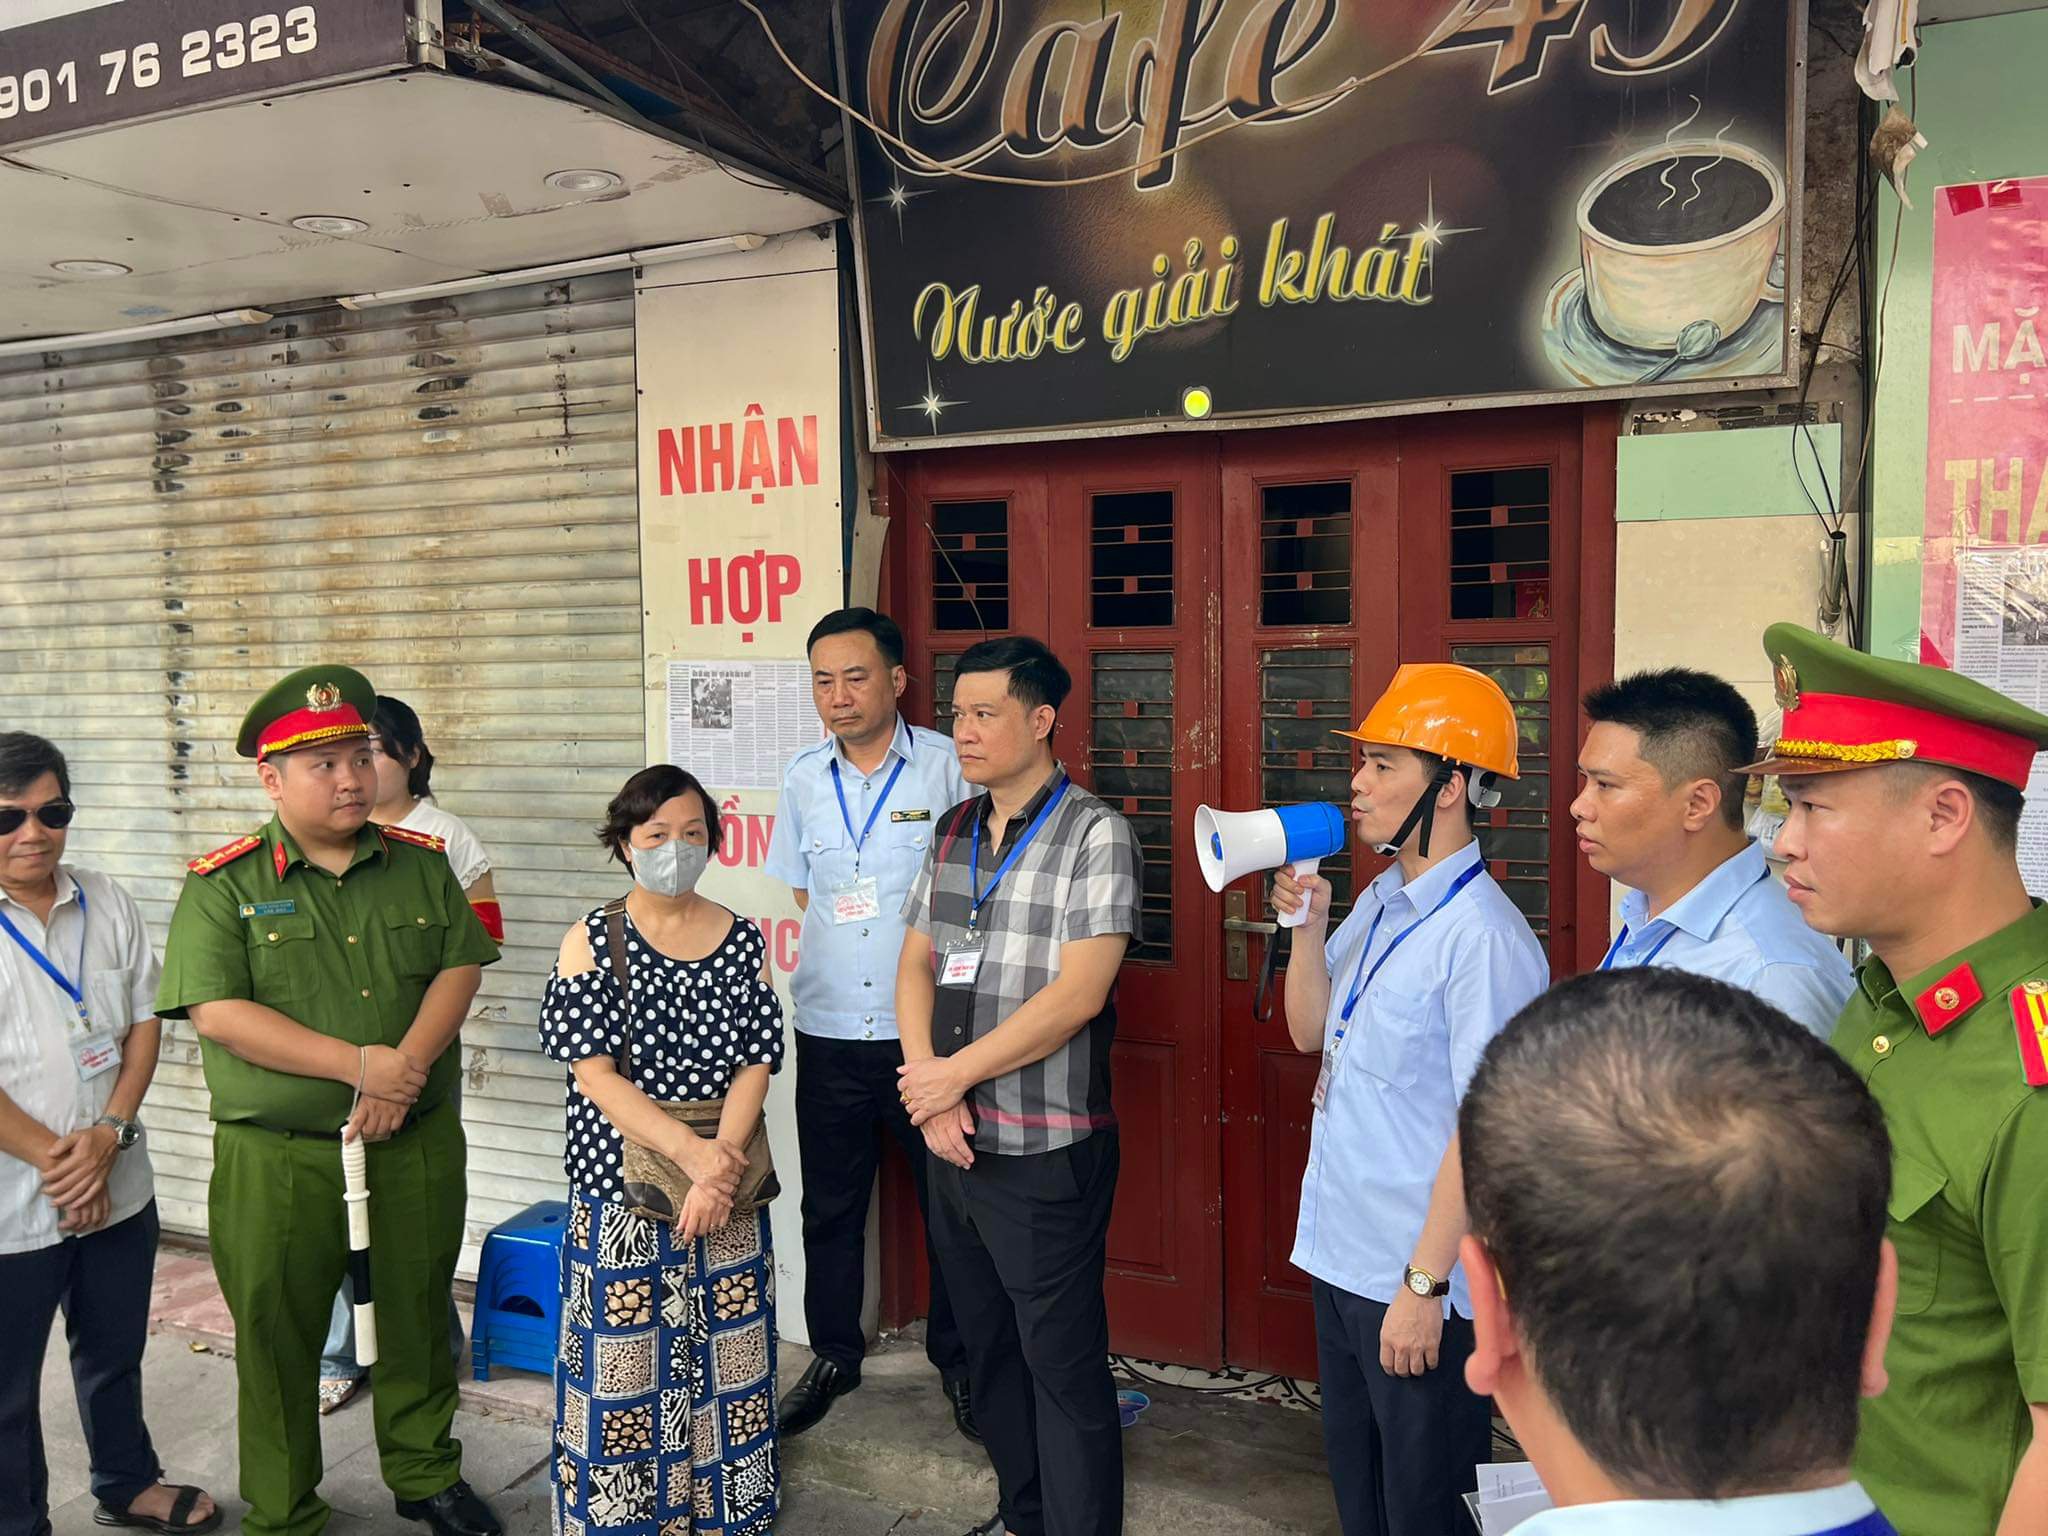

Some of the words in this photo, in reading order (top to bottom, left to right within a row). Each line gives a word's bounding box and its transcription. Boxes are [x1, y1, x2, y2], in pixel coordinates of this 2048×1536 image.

[0, 61, 77, 119] 901
[100, 42, 160, 95] 76
[182, 6, 317, 77] 2323
[913, 282, 1086, 364] Nước
[1103, 236, 1239, 362] giải
[1259, 211, 1433, 307] khát
[658, 403, 819, 504] NHẬN
[688, 550, 801, 643] HỢP
